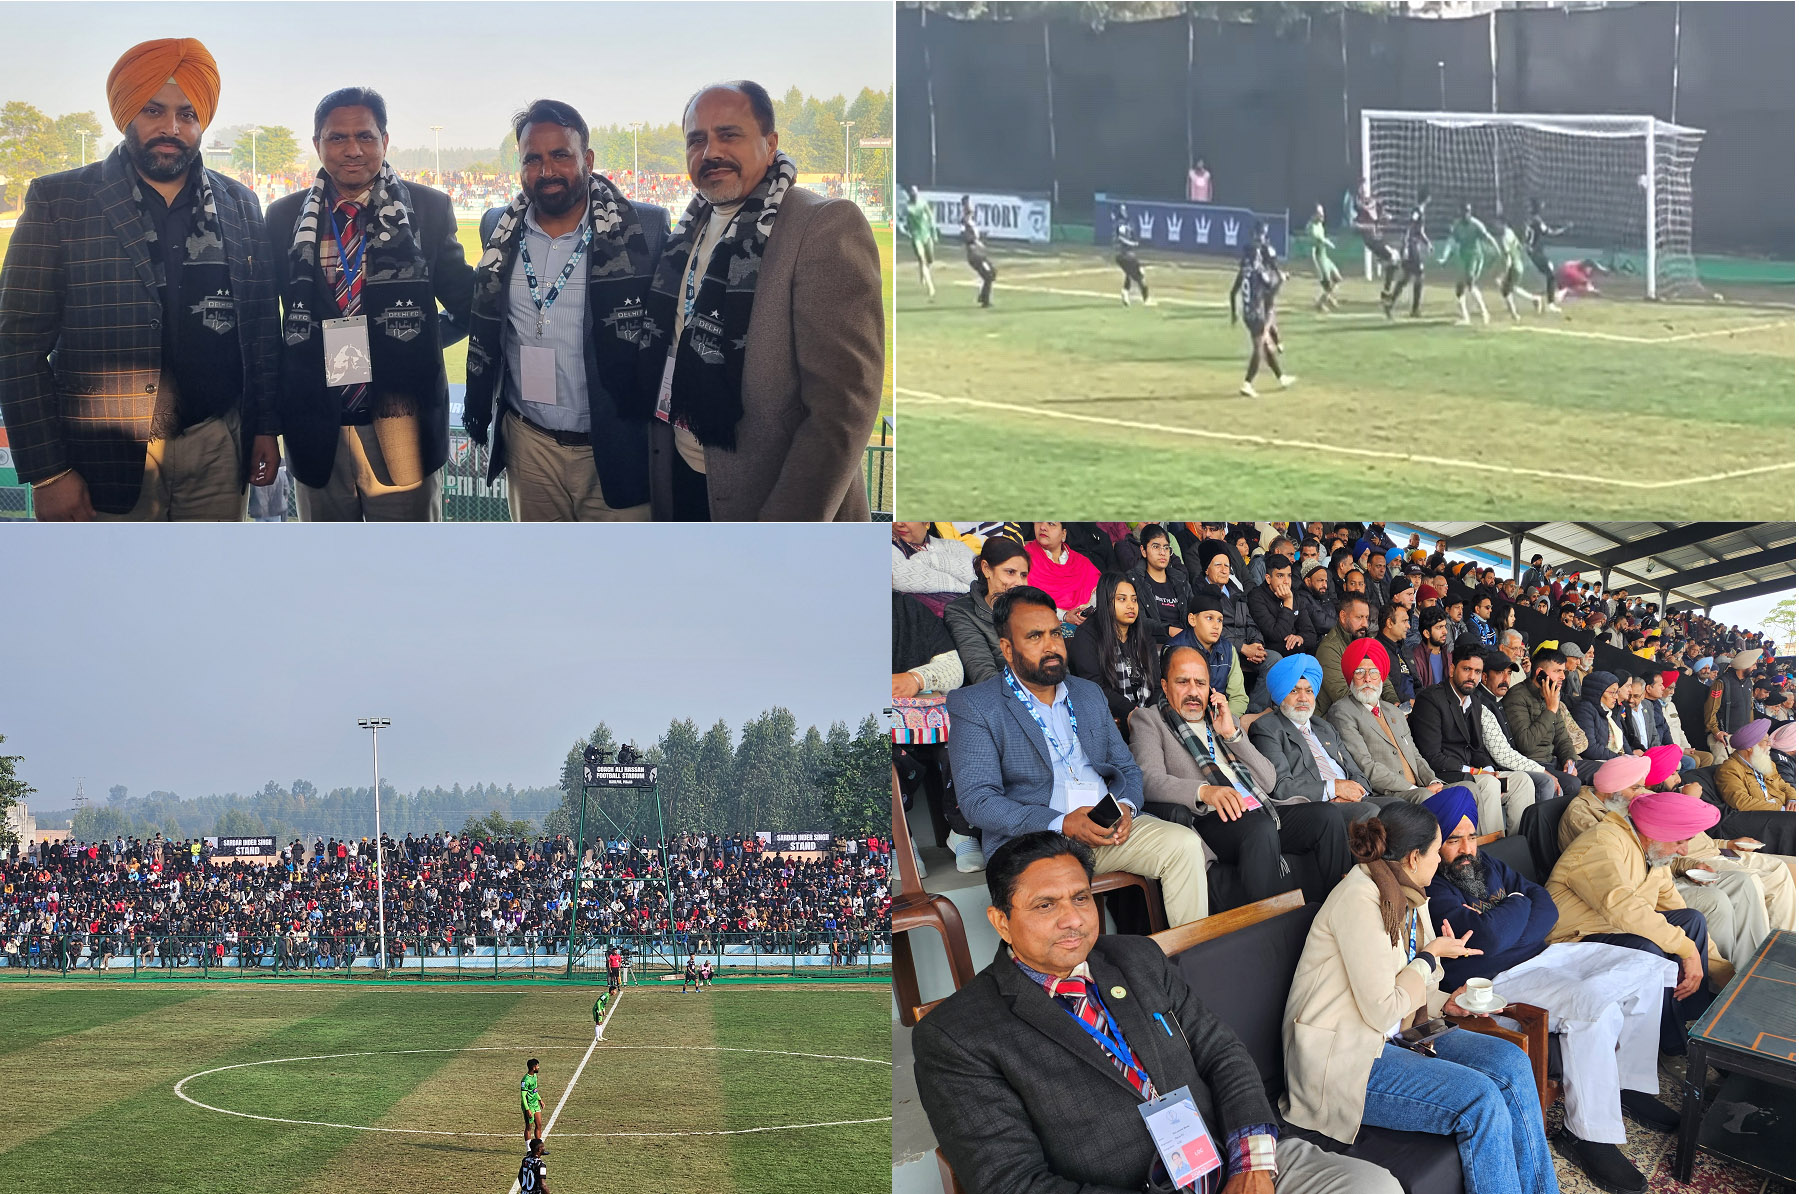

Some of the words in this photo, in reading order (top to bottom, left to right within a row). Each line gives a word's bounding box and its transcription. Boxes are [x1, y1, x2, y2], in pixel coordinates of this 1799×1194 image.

[698, 320, 722, 334] DELHI
[790, 842, 816, 850] STAND
[236, 847, 260, 855] STAND
